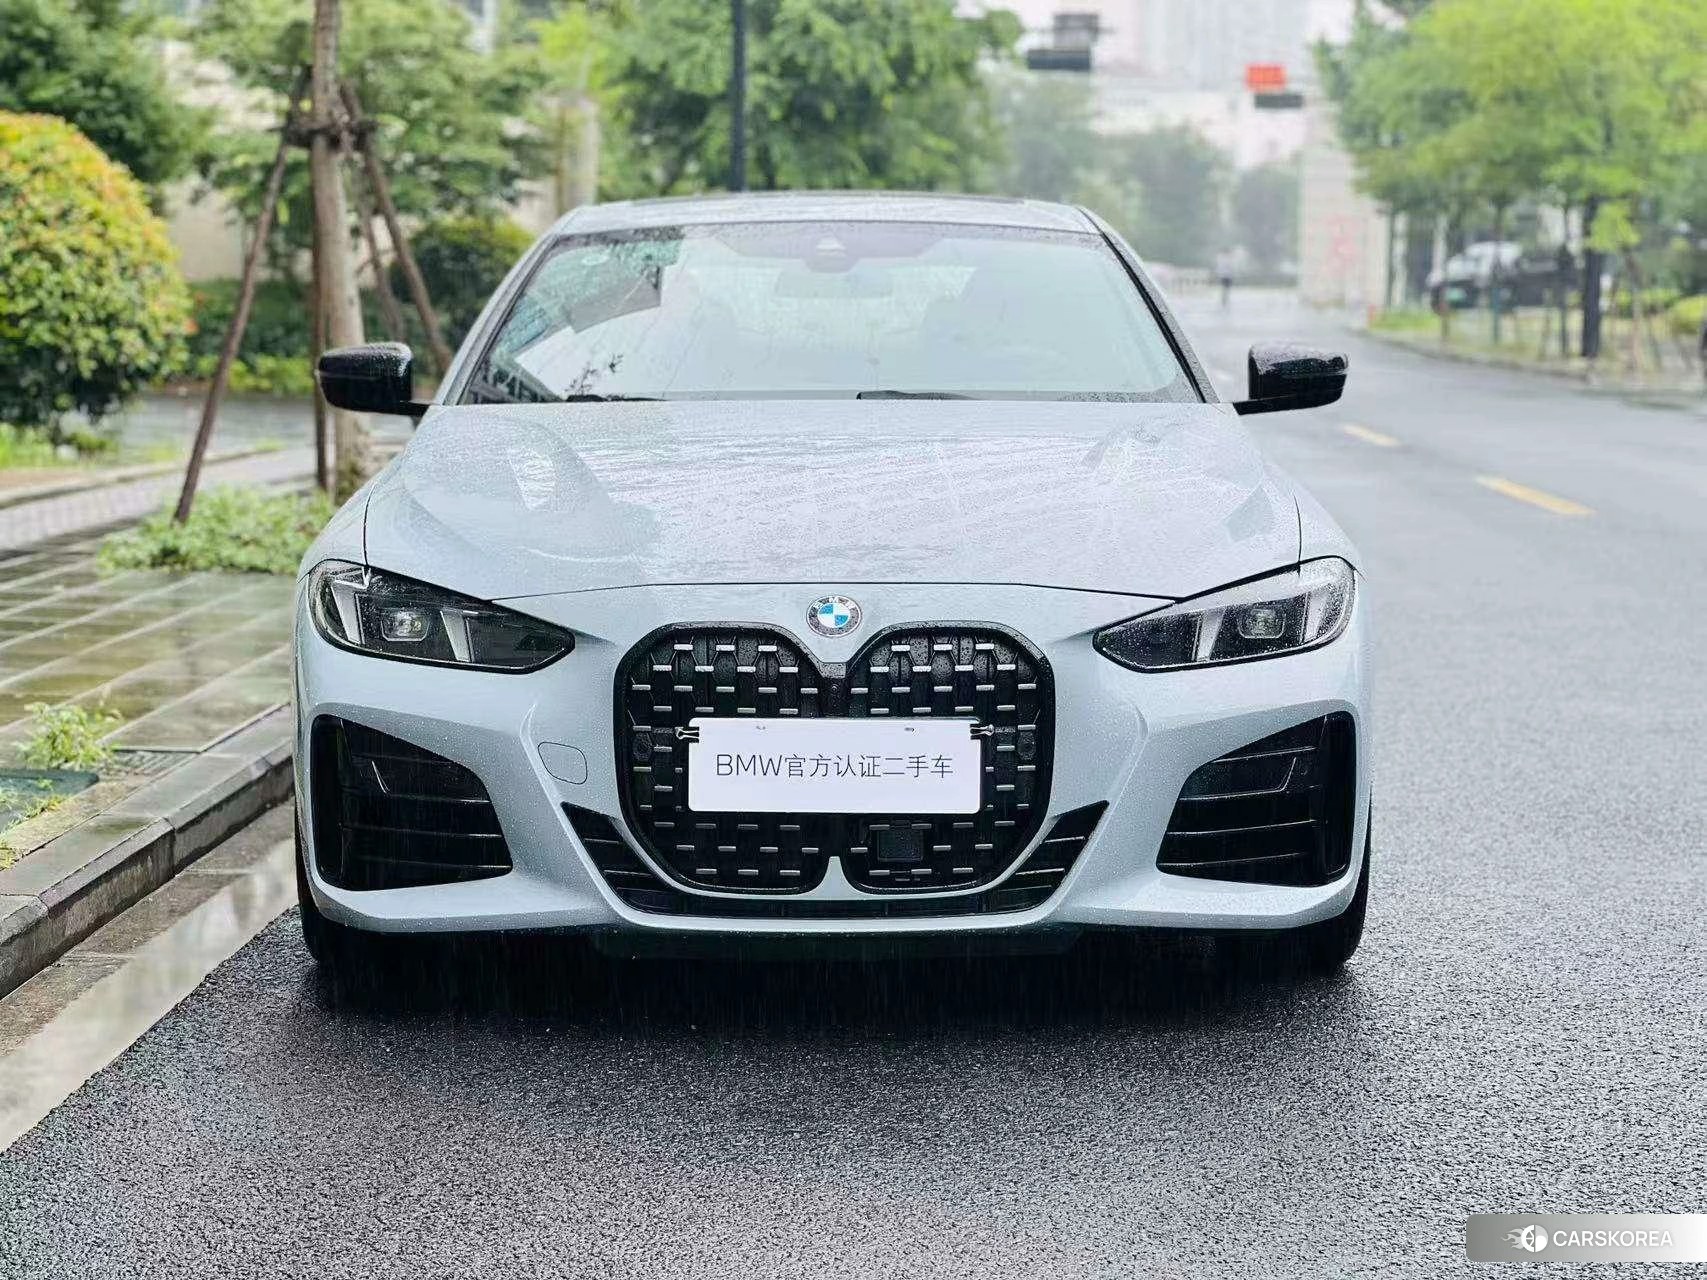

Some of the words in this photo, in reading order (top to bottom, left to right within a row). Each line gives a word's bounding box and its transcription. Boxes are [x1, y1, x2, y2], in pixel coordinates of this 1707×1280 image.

[812, 596, 856, 609] BMW
[716, 753, 954, 778] BMW官方认证二手车
